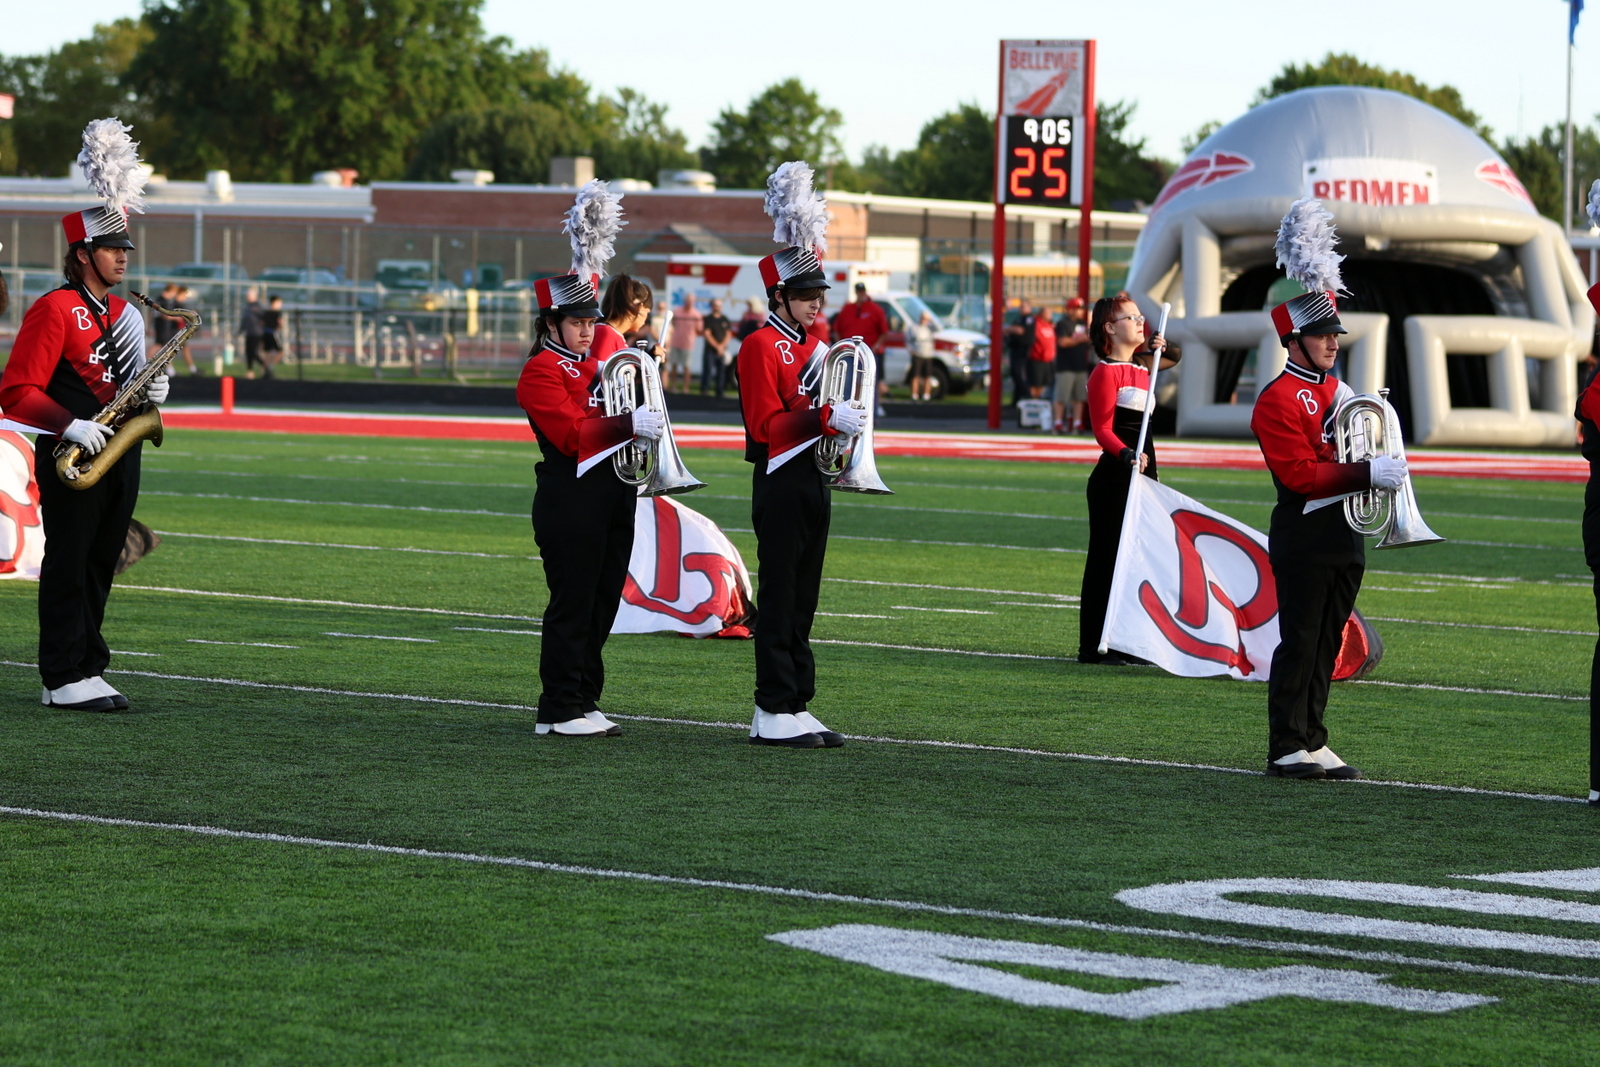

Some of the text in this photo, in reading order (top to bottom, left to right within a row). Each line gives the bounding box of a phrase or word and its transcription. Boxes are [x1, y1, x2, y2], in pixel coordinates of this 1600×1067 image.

[1009, 49, 1079, 71] BELLEVUE
[1010, 147, 1067, 197] 25
[71, 305, 93, 331] B
[774, 339, 795, 365] B
[556, 359, 581, 378] B
[1296, 388, 1319, 416] B
